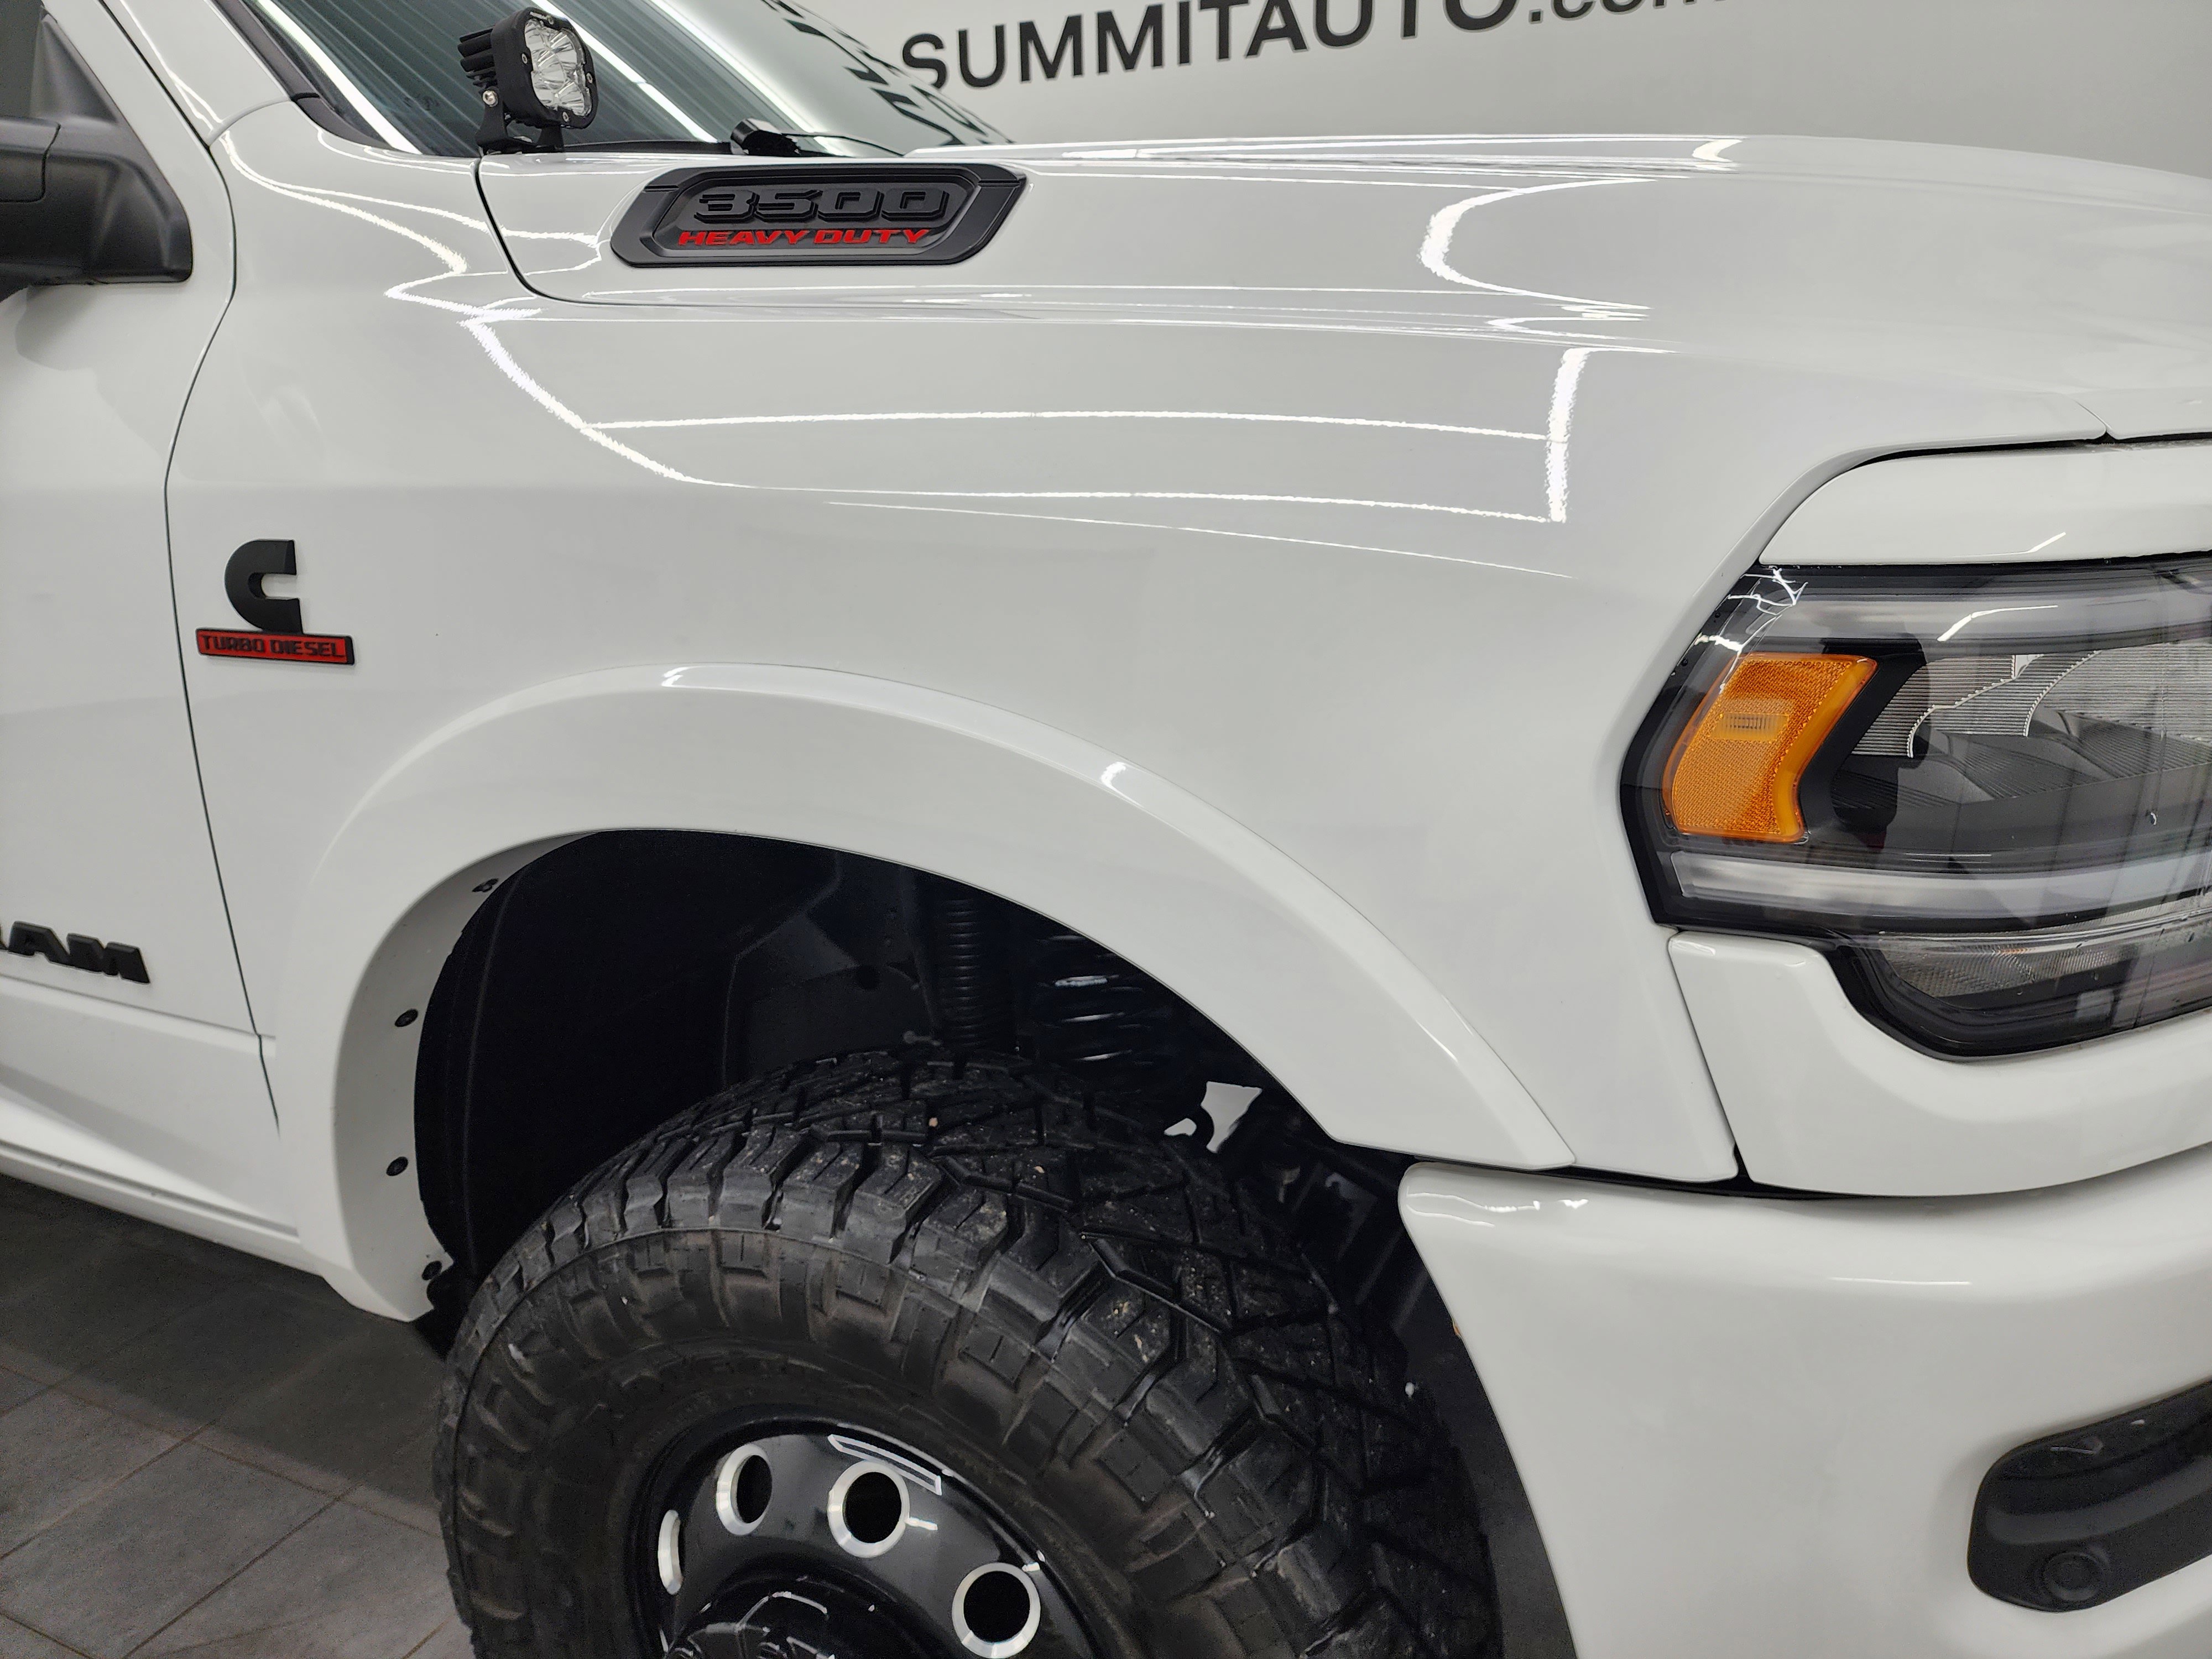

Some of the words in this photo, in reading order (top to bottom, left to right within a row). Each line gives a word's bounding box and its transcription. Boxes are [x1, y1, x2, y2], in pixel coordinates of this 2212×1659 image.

[901, 0, 1728, 88] SUMMITAU.
[694, 189, 950, 223] 3500
[678, 229, 811, 246] HEAVY
[813, 228, 930, 245] DUTY
[200, 635, 265, 654] TURBO
[270, 639, 346, 658] DIESEL
[0, 921, 150, 984] AM
